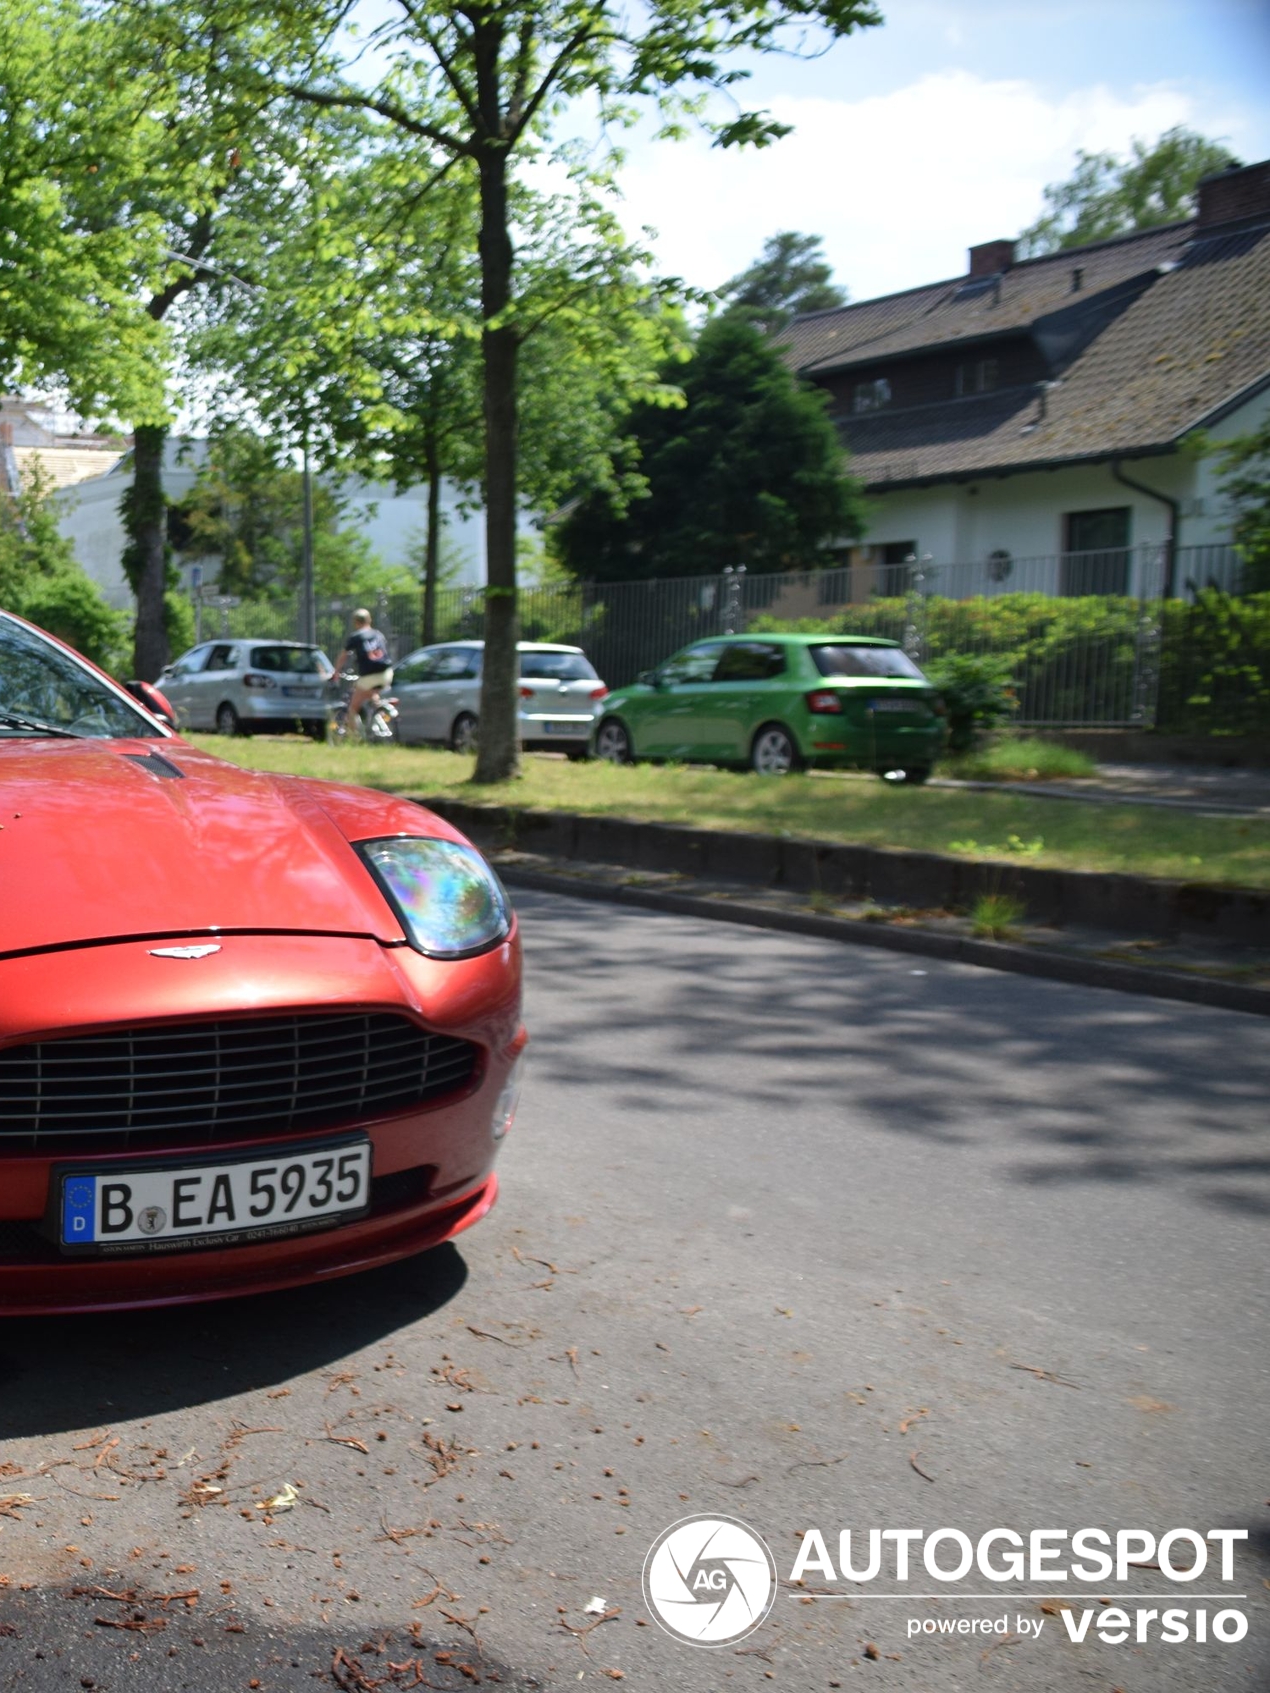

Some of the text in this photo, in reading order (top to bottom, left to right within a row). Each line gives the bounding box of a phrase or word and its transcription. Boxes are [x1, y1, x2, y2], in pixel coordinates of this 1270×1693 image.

[101, 1153, 362, 1234] B EA 5935
[74, 1216, 86, 1231] D
